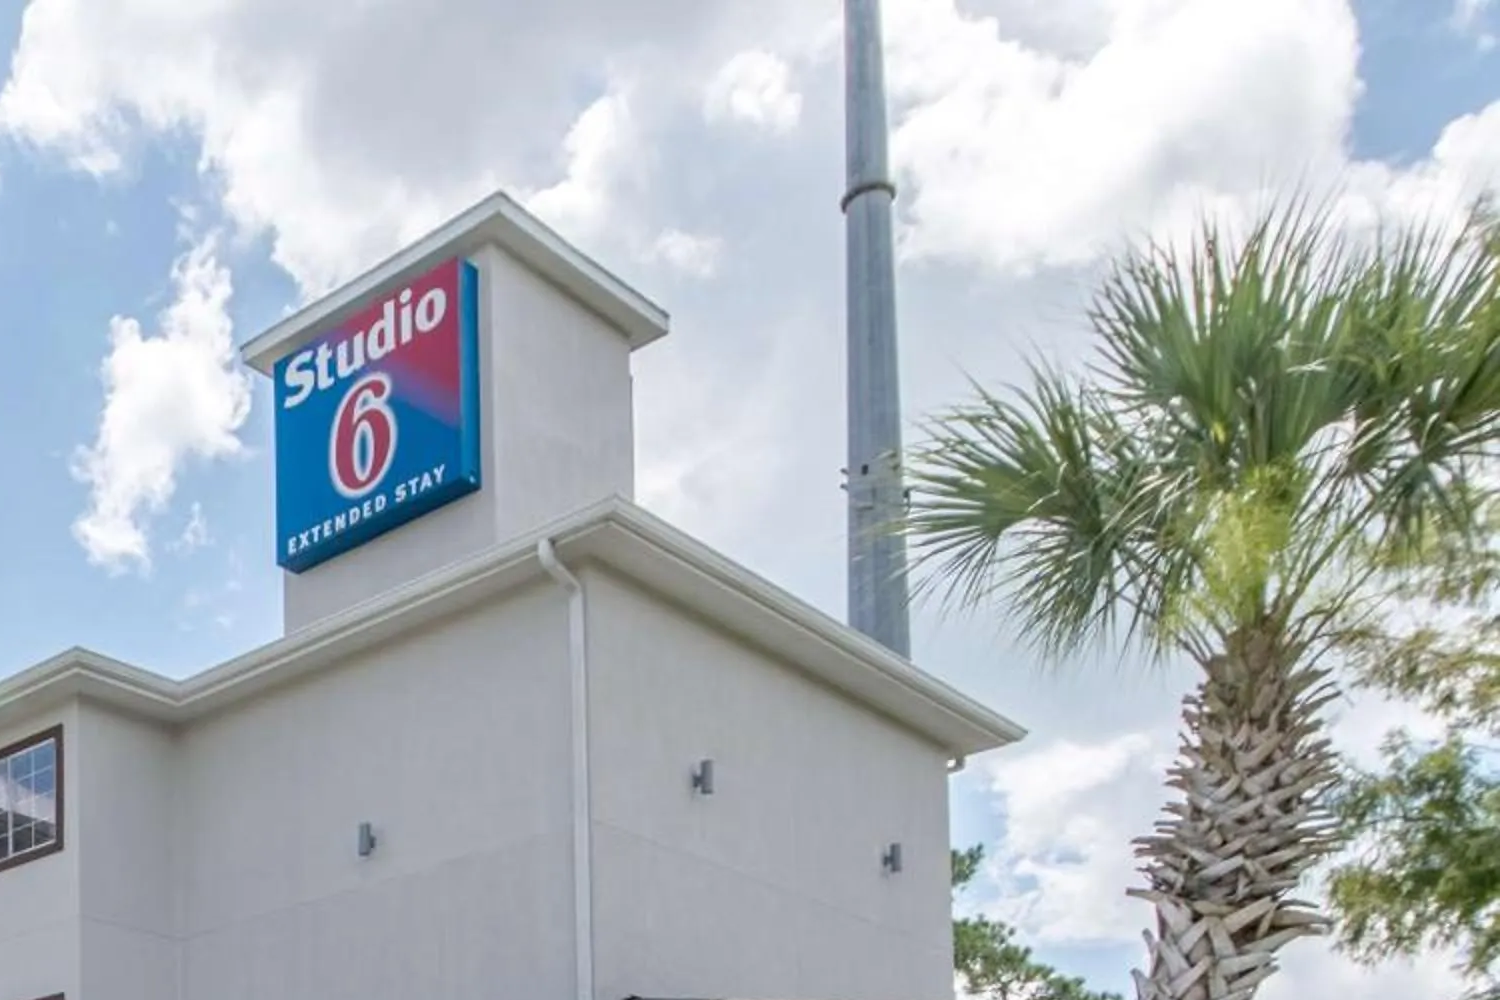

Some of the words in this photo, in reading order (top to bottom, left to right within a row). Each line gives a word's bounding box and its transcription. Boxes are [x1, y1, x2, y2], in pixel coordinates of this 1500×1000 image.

[284, 287, 447, 409] Studio
[330, 372, 398, 499] 6
[287, 495, 387, 555] EXTENDED
[395, 464, 446, 502] STAY
